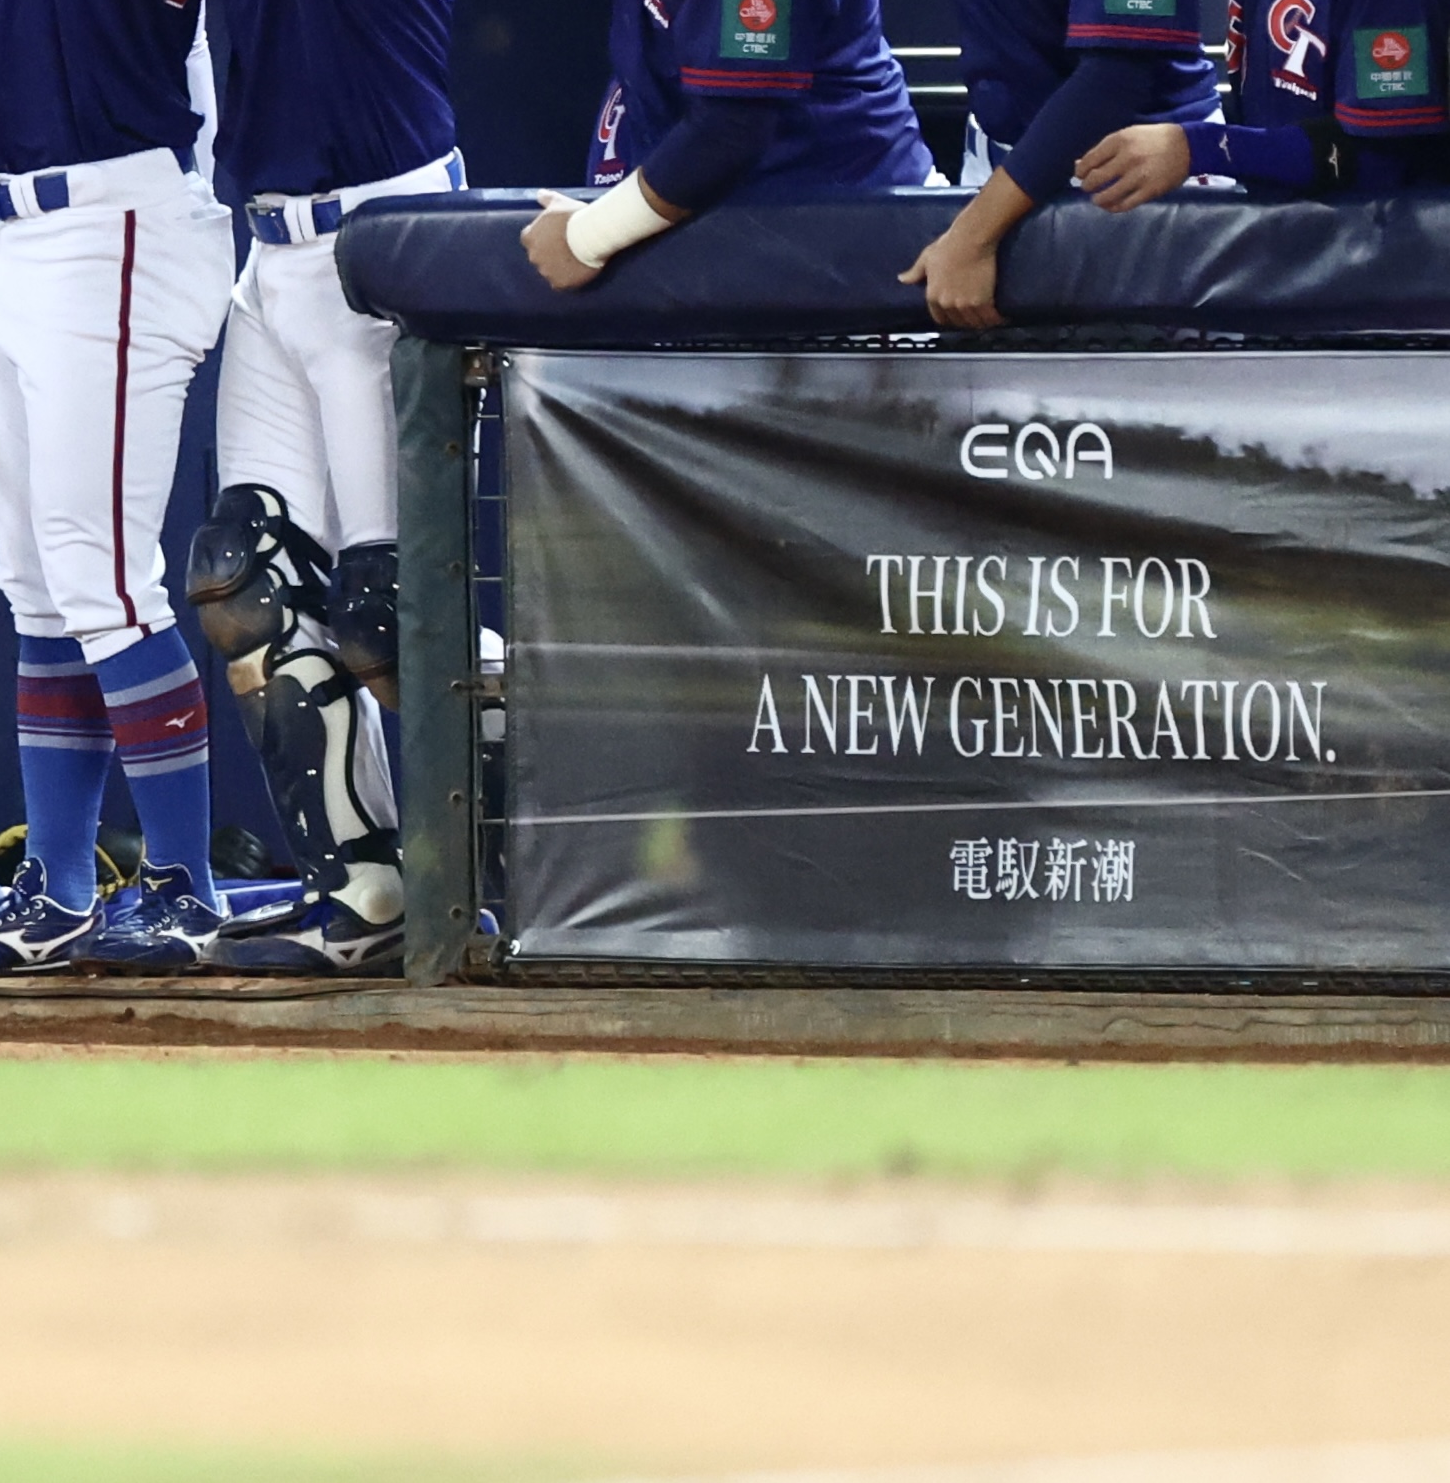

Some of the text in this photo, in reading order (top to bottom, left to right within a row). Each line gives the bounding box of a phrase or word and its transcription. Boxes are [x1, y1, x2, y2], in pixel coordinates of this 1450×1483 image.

[960, 422, 1113, 480] EQA
[866, 554, 1218, 639] THIS IS FOR
[746, 674, 1338, 763] A NEW GENERATION.
[949, 837, 1137, 903] 電馭新潮
